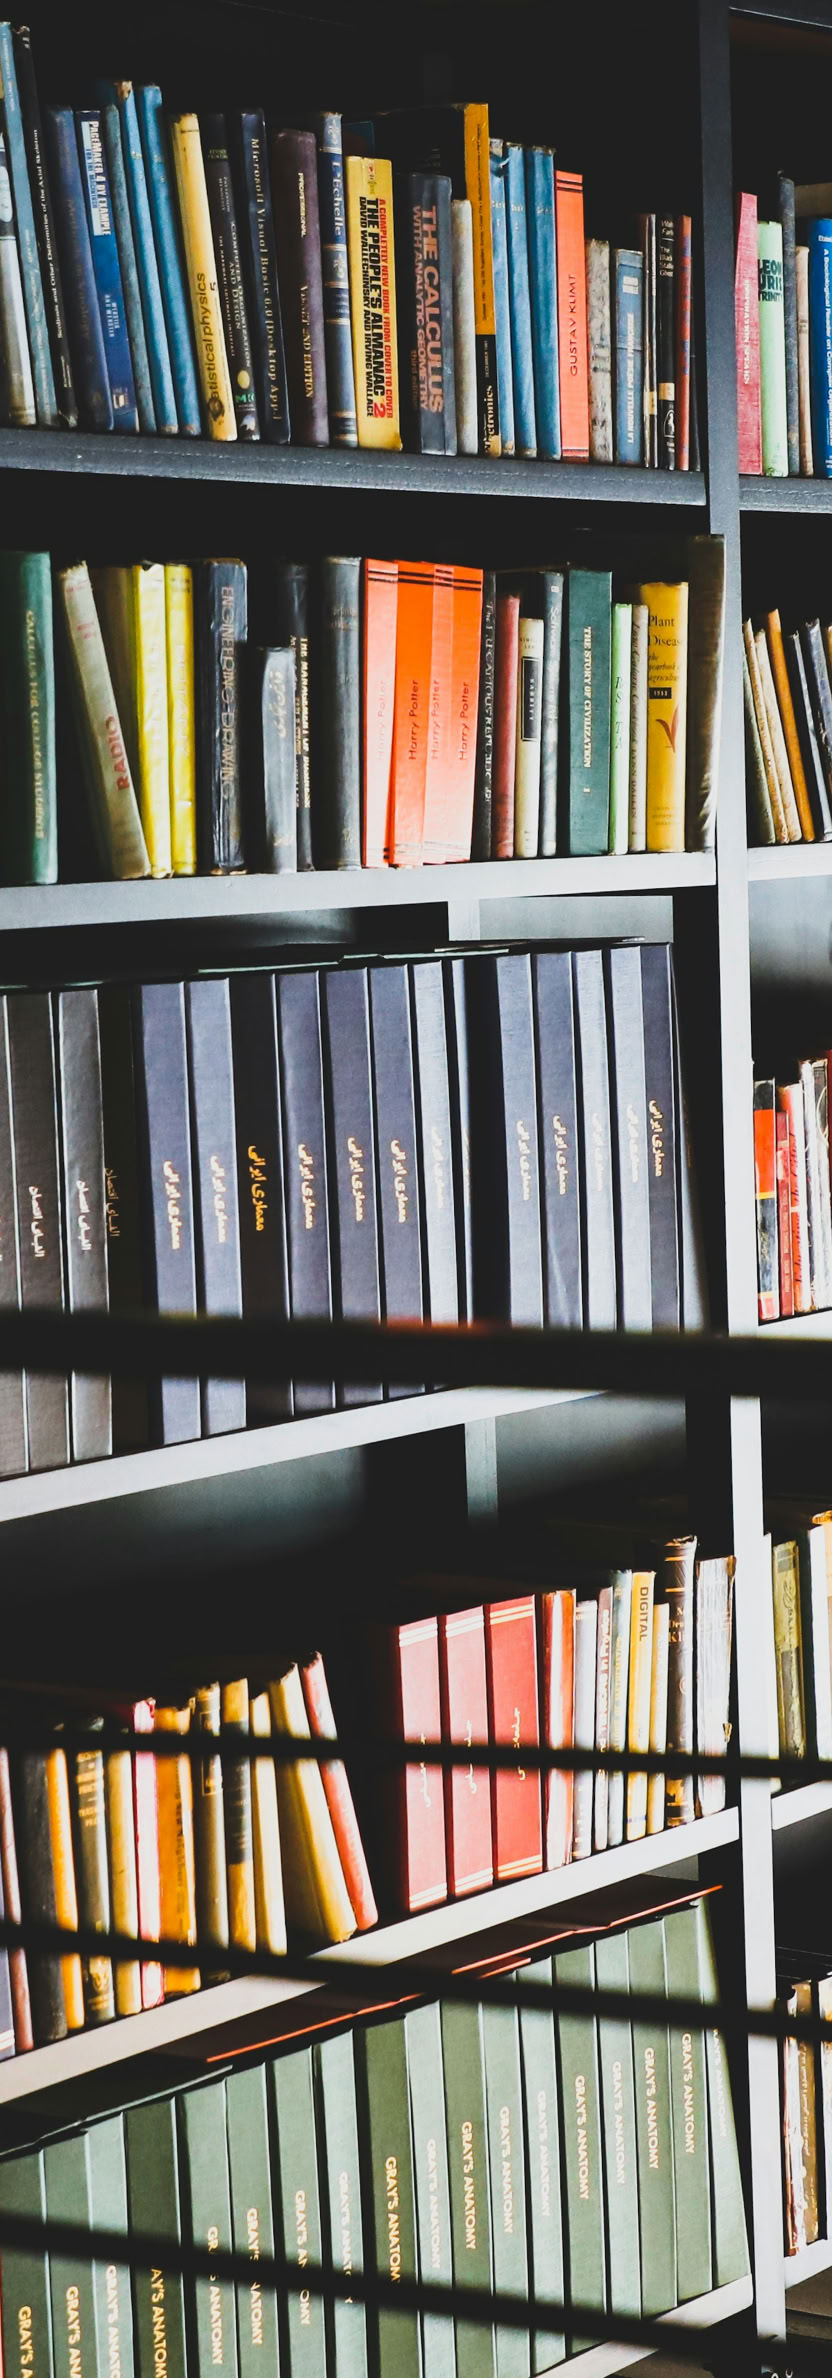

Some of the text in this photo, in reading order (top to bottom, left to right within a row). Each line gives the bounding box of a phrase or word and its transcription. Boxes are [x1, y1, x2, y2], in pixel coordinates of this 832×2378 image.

[33, 129, 41, 163] Skeleton
[251, 138, 264, 203] Microsoft
[36, 166, 44, 187] Axial
[297, 172, 307, 237] PROFESSIONAL
[41, 203, 48, 212] of
[42, 214, 53, 260] Deformities
[98, 197, 112, 235] EXAMPLE
[257, 208, 269, 252] Visual
[367, 198, 380, 228] THE
[380, 206, 389, 263] COMPLETELY
[48, 263, 57, 286] Other
[260, 257, 272, 294] Basic
[368, 232, 382, 309] PEOPLE'S
[382, 266, 390, 288] NEW
[823, 248, 829, 256] A
[196, 273, 213, 335] physics
[359, 196, 375, 416] DAVID WALLECHINSKY AND IRVING WALLACE
[382, 289, 391, 314] BOOK
[413, 205, 429, 411] WITH ANALYTIC GEOMETRY
[421, 206, 444, 413] THE CALCULUS
[823, 257, 831, 307] Sociological
[54, 305, 63, 338] Scoliosis
[383, 316, 391, 342] FROM
[568, 273, 578, 377] GUSTAV KLIMT
[826, 338, 832, 350] on
[303, 353, 314, 398] EDITION
[371, 312, 385, 397] ALMANAC
[384, 345, 392, 374] COVER
[385, 376, 393, 387] TO
[627, 431, 635, 444] LA
[300, 638, 308, 657] THE
[648, 615, 675, 627] Plant
[221, 586, 235, 799] ENGINEERING DRAWING
[375, 679, 386, 760] Harry Potter
[408, 679, 420, 760] Harry Potter
[430, 679, 441, 760] Harry Potter
[458, 681, 470, 760] Harry Potter
[583, 626, 593, 768] THE STORY OF CIVILIZATION
[106, 716, 130, 791] RADIO
[252, 1183, 268, 1231] معماری
[600, 1609, 610, 1658] Physics
[640, 1586, 649, 1642] DIGITAL
[612, 2061, 625, 2185] GRAY'S ANATOMY
[644, 2047, 659, 2169] GRAY'S ANATOMY
[682, 2033, 695, 2154] GRAY'S ANATOMY
[575, 2074, 589, 2200] GRAY'S ANATOMY
[461, 2121, 476, 2249] GRAY'S ANATOMY
[499, 2106, 513, 2233] GRAY'S ANATOMY
[540, 2144, 550, 2216] ANATOMY
[295, 2189, 307, 2245] GRAY'S
[385, 2156, 401, 2282] GRAY'S ANATOM
[430, 2194, 441, 2268] ANATOMY
[106, 2264, 119, 2323] GRAY'S
[151, 2268, 165, 2302] AY'S
[18, 2305, 33, 2364] GRAY'S
[66, 2285, 81, 2345] GRAY'S
[209, 2286, 223, 2364] ANATOMY
